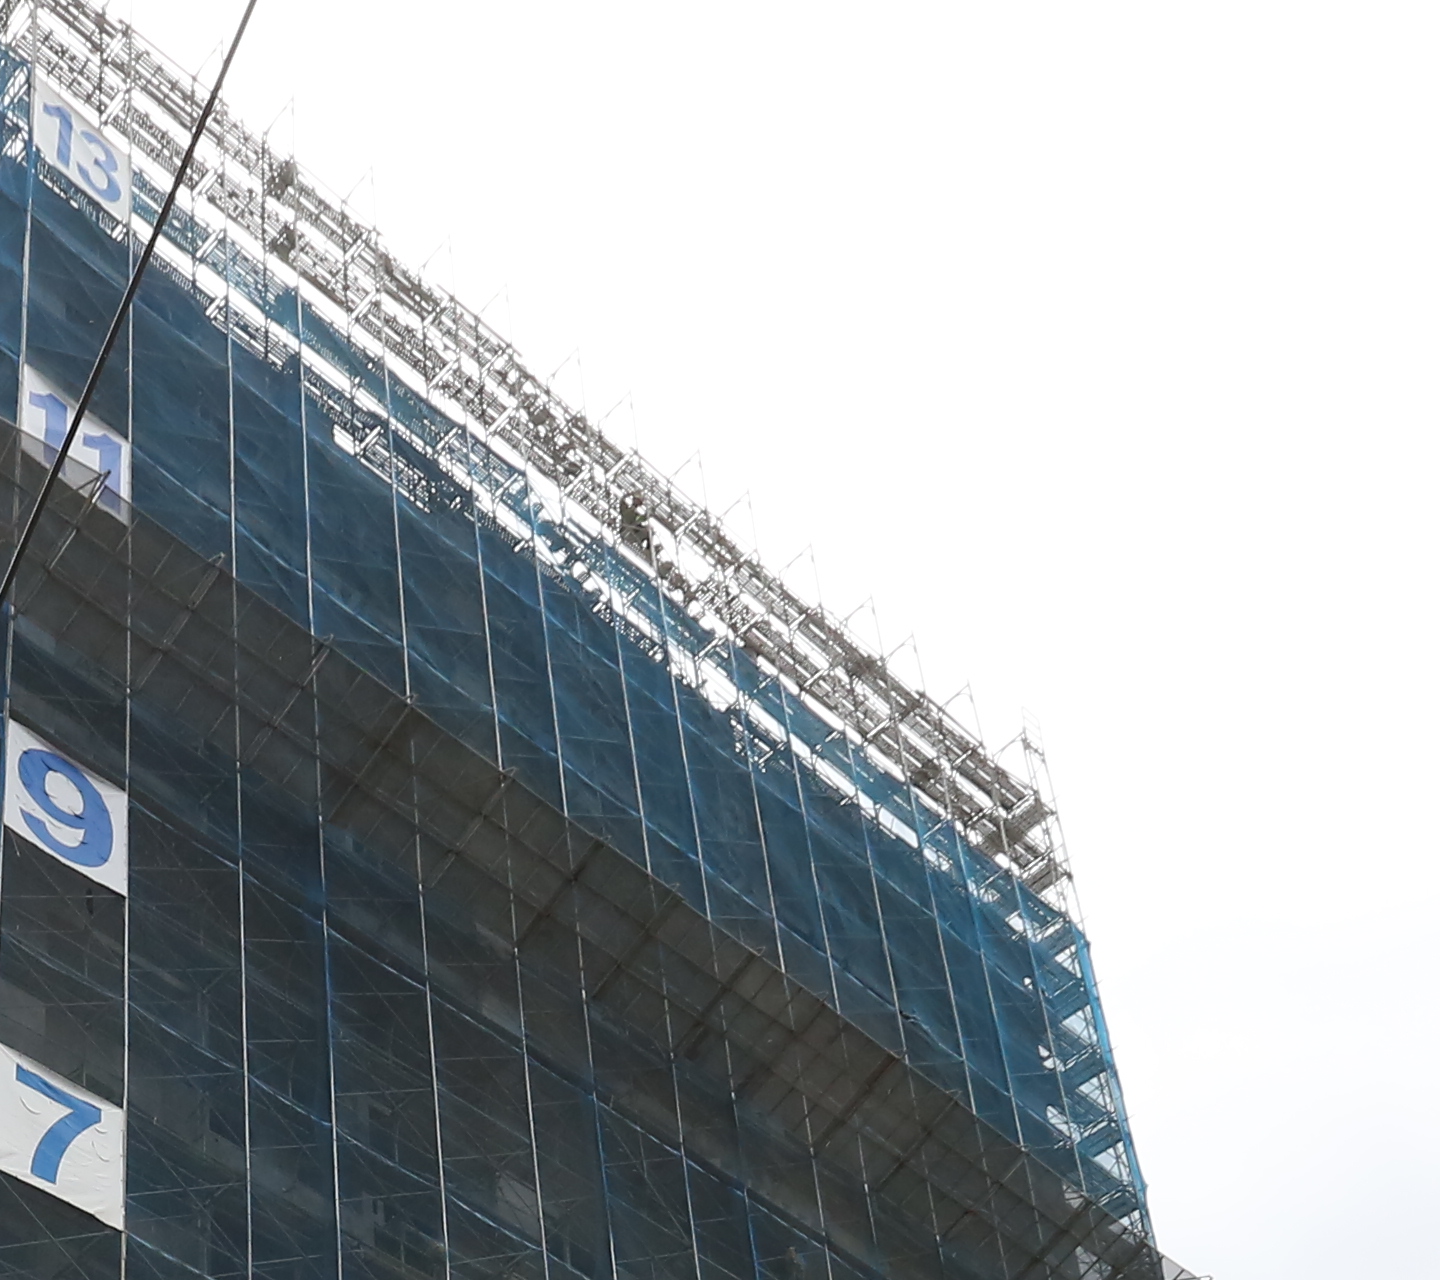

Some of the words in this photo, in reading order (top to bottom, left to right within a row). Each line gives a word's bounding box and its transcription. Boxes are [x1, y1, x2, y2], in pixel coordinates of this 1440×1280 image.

[42, 101, 122, 201] 13
[28, 392, 123, 514] 11
[18, 746, 115, 869] 9
[15, 1062, 102, 1186] 7
